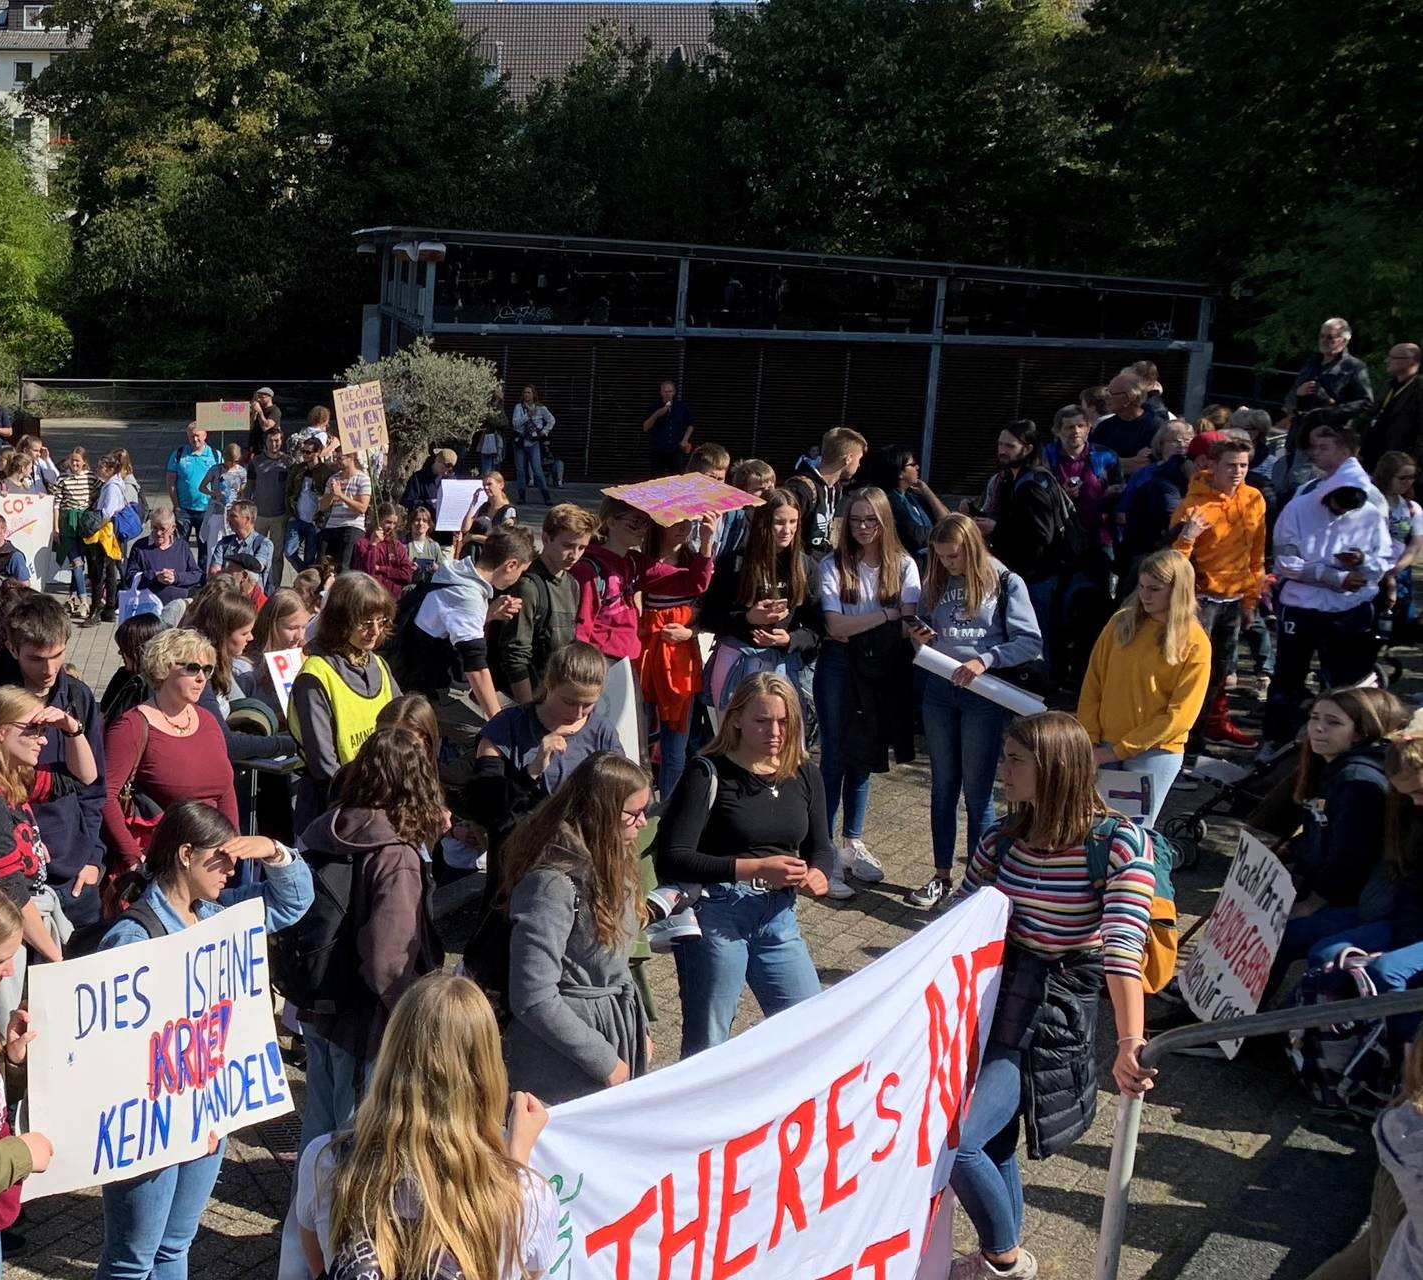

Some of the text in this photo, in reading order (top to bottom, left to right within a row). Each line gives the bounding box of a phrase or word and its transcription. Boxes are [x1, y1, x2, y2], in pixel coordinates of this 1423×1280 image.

[1283, 621, 1296, 635] 12
[74, 925, 265, 1041] DIES IST EINE
[147, 998, 233, 1100] KRISE!
[92, 1040, 286, 1176] KEIN WANDEL!
[585, 1059, 903, 1280] THERE'S
